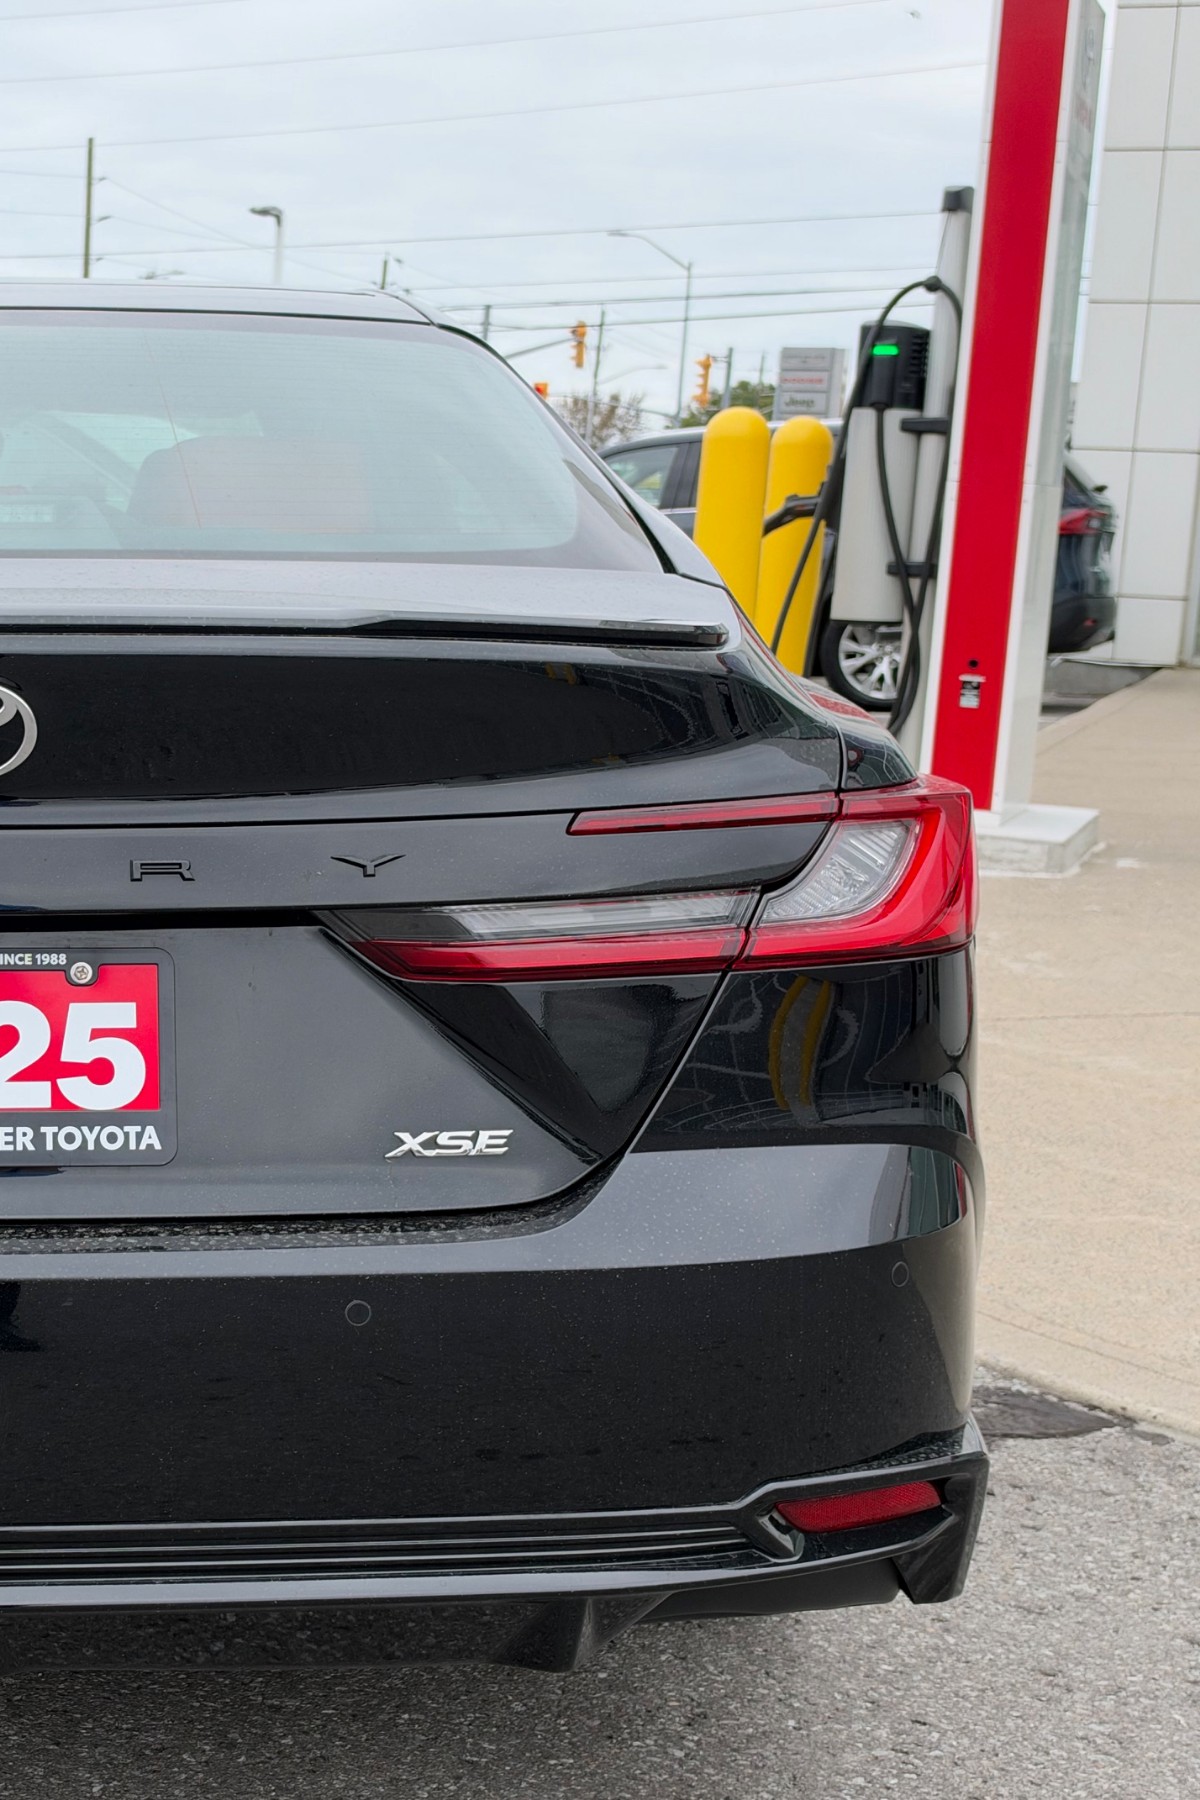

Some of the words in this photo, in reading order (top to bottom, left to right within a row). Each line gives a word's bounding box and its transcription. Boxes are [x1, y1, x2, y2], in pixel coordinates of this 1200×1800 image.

[34, 952, 68, 965] 1988
[39, 1125, 163, 1151] TOYOTA
[384, 1129, 514, 1158] XSE
